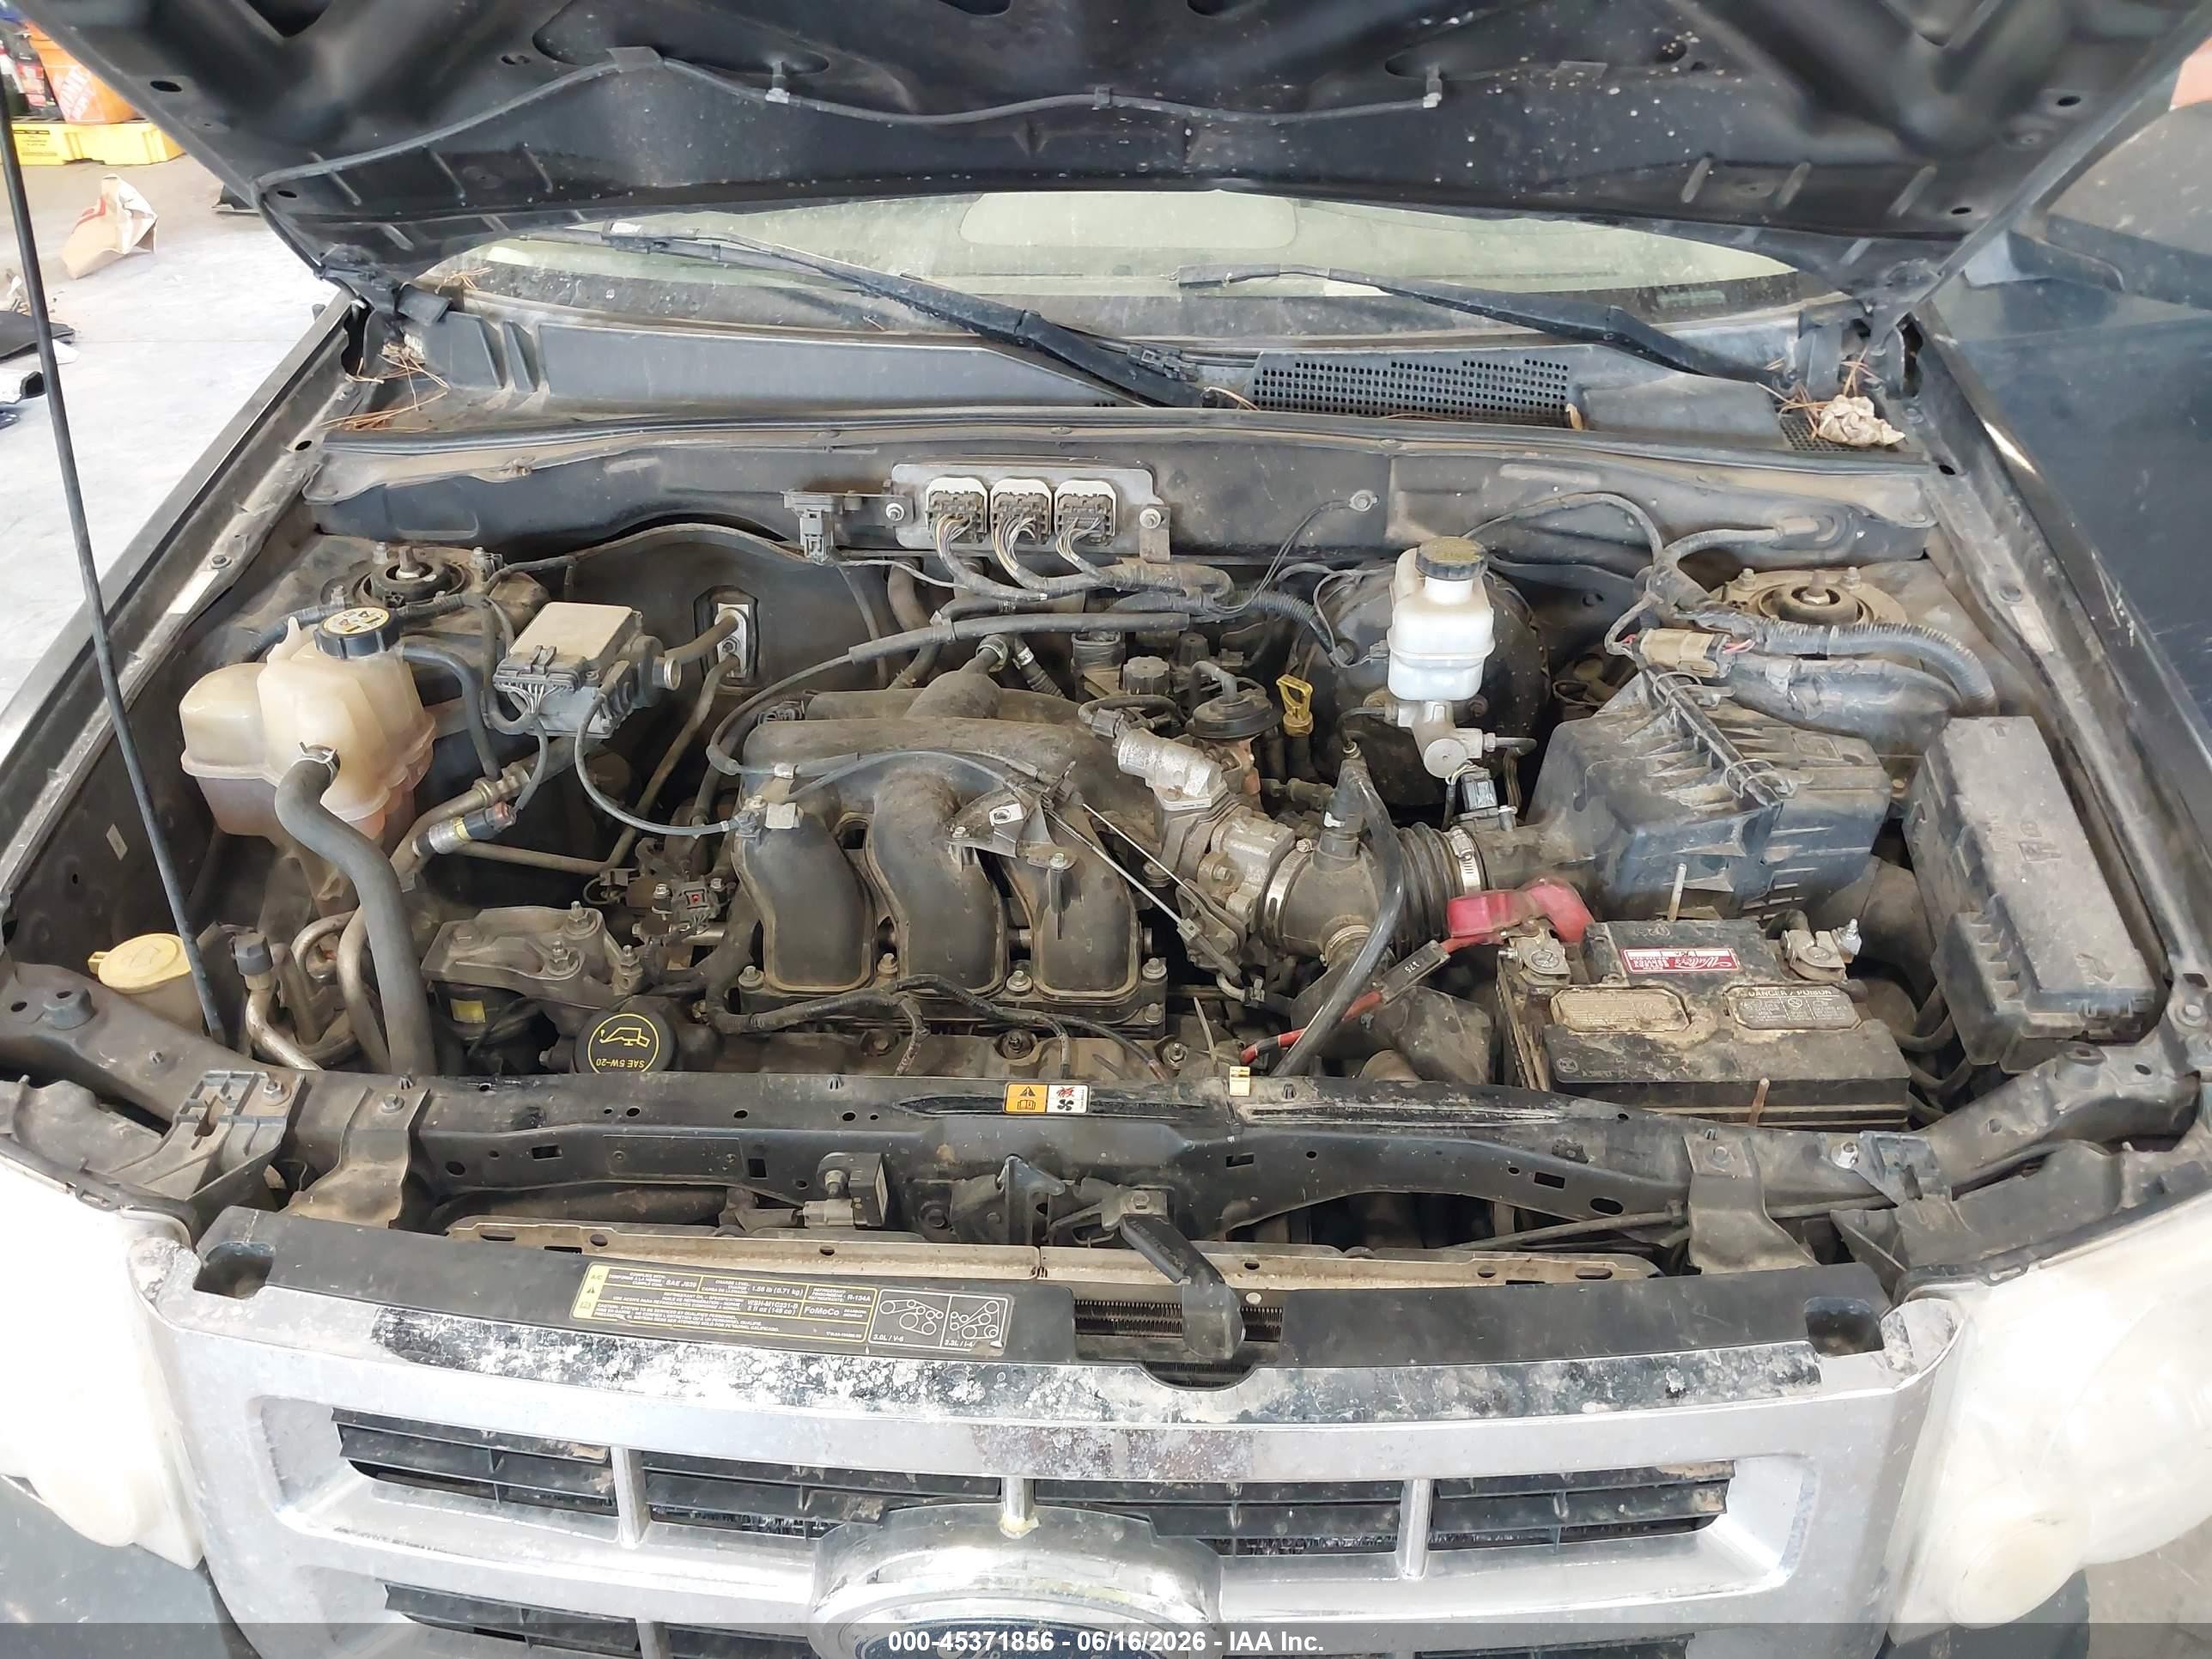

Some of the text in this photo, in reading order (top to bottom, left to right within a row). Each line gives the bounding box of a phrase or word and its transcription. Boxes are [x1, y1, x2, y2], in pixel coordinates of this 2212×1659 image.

[595, 1058, 646, 1067] SAE 5W-20
[804, 1307, 841, 1316] FoMoCo
